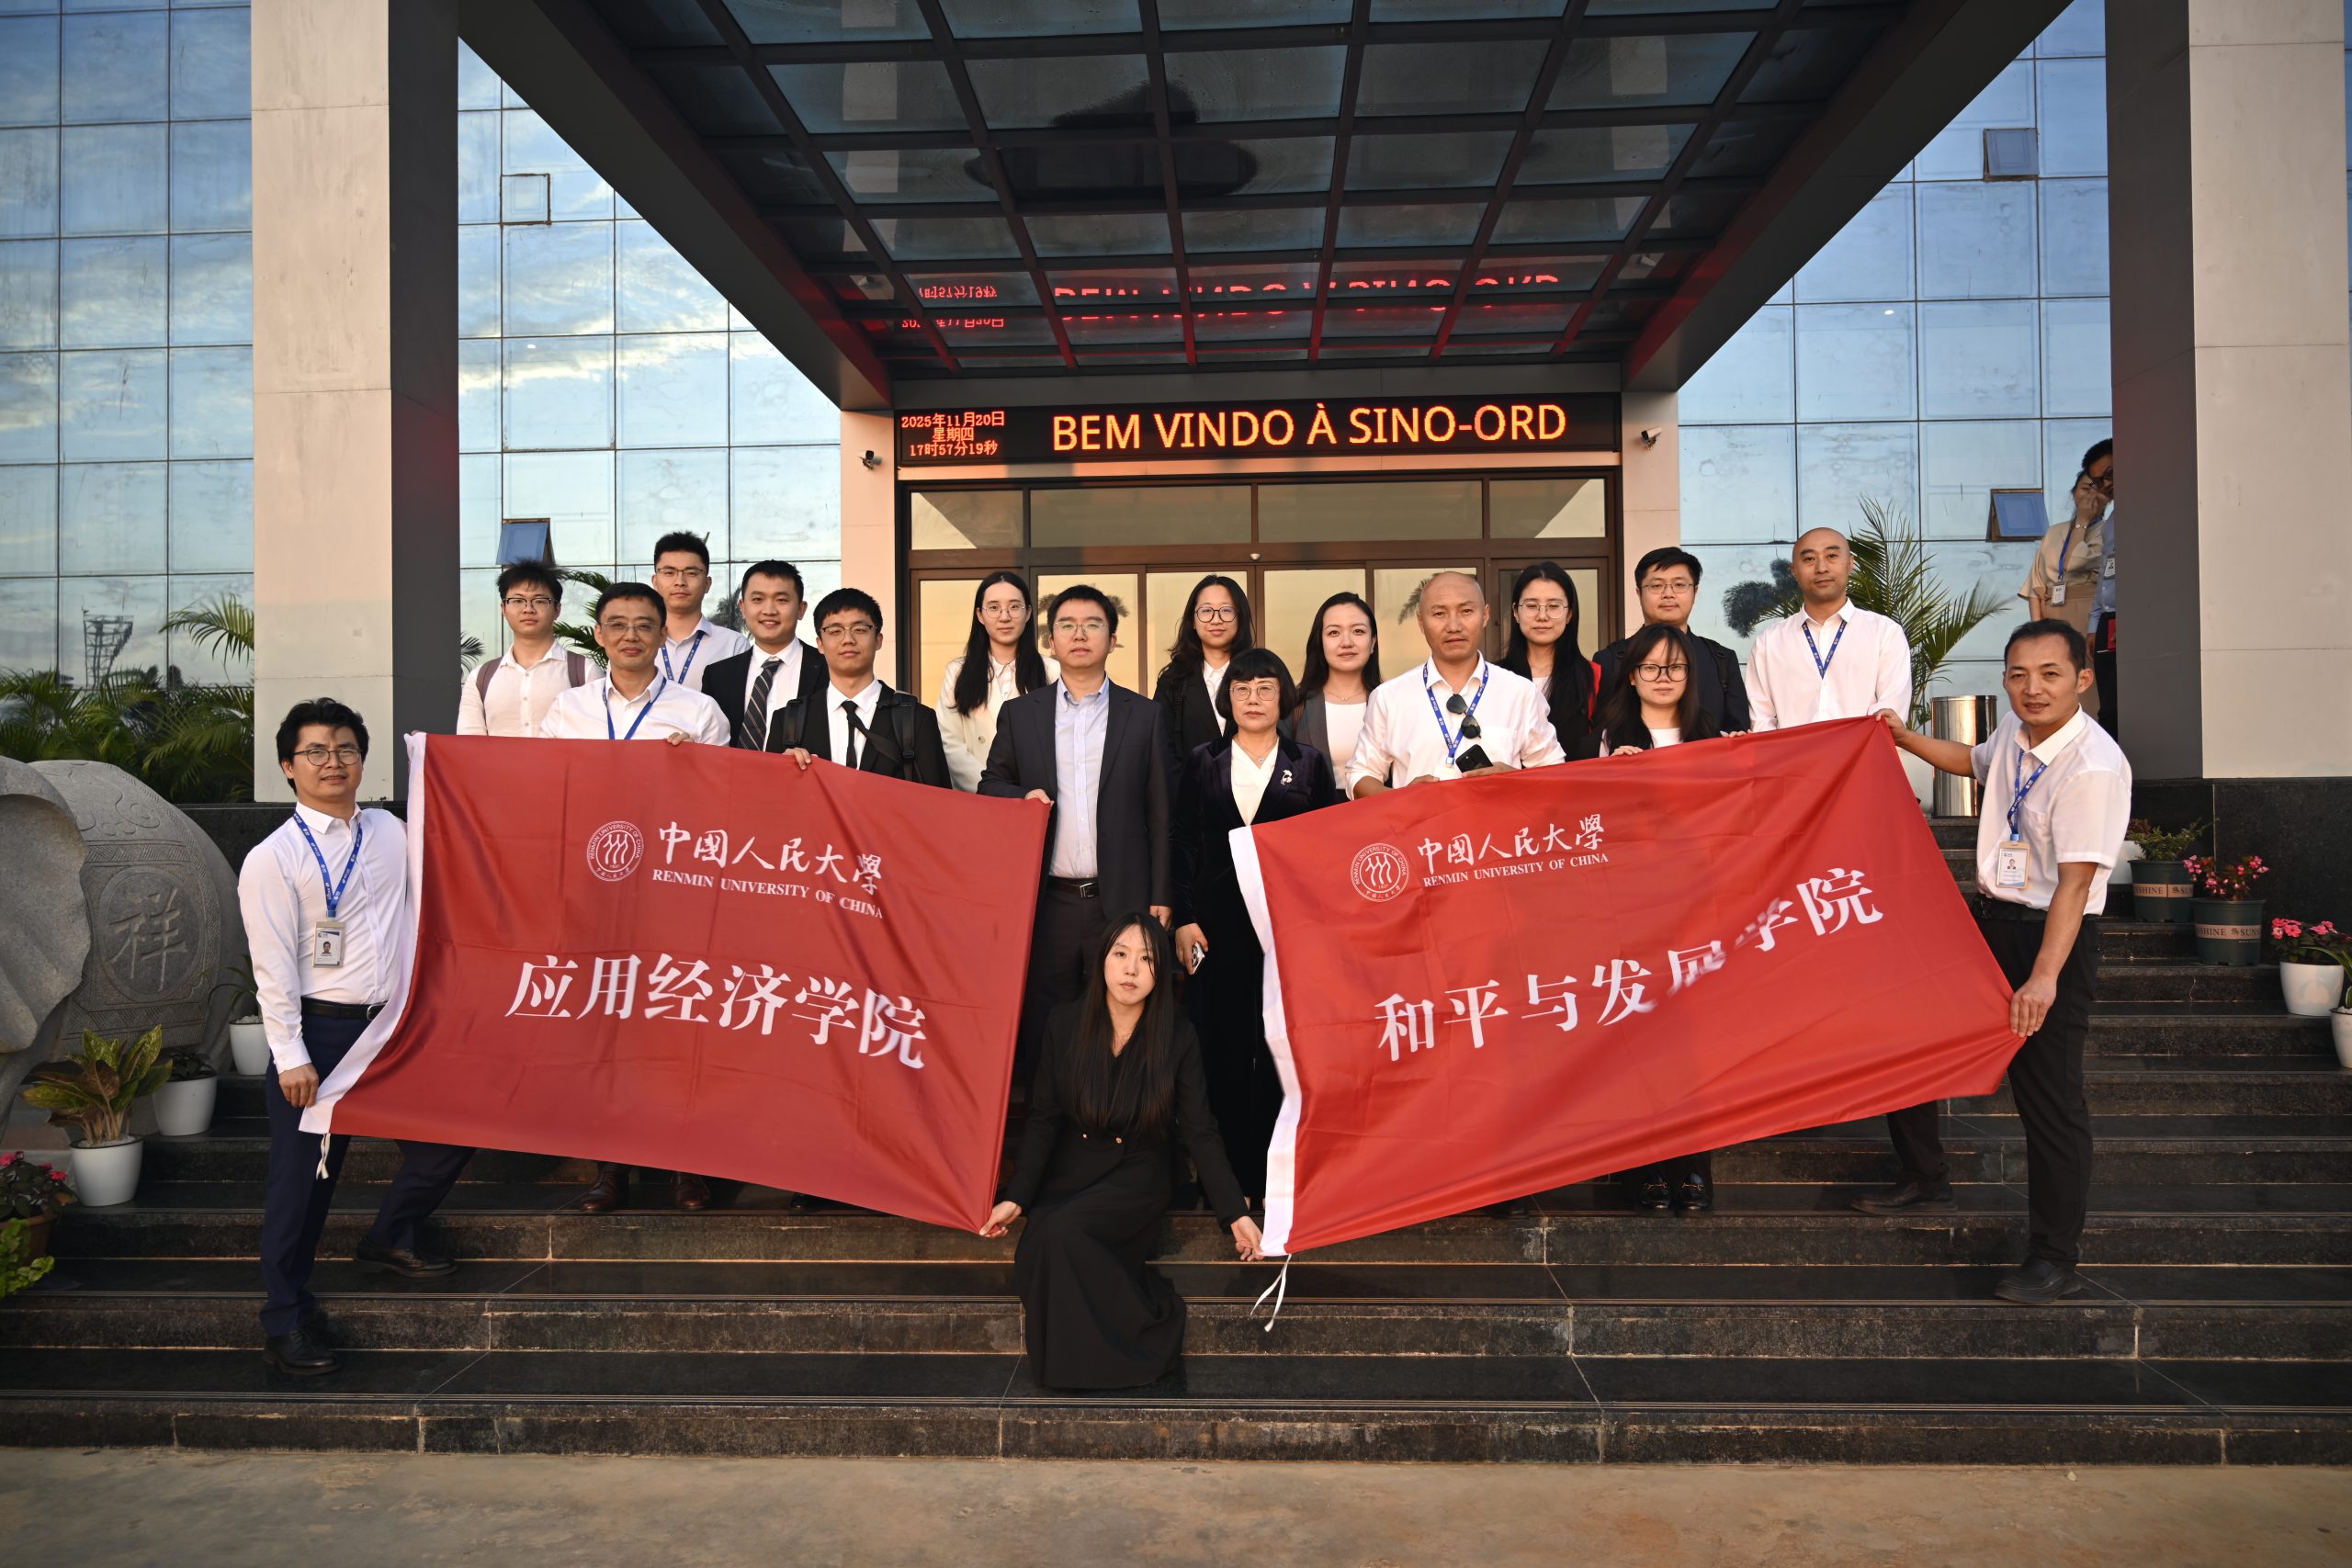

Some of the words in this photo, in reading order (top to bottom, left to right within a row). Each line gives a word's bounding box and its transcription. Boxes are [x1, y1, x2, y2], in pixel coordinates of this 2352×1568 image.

[901, 411, 1005, 428] 2025年11月20日
[932, 427, 975, 443] 星期四
[1053, 414, 1140, 451] BEM
[1154, 410, 1295, 448] VINDO
[1306, 402, 1338, 445] À
[1349, 404, 1566, 444] SINO-ORD
[910, 439, 999, 457] 17时57分19秒
[1422, 871, 1469, 887] RENMIN
[1474, 861, 1544, 880] UNIVERSITY
[1549, 858, 1565, 871] OF
[1569, 853, 1609, 867] CHINA
[652, 869, 714, 887] RENMIN
[720, 877, 810, 898] UNIVERSITY
[815, 889, 835, 904] OF
[839, 897, 884, 919] CHINA
[108, 887, 187, 993] 祥
[504, 953, 927, 1069] 应用经济学院
